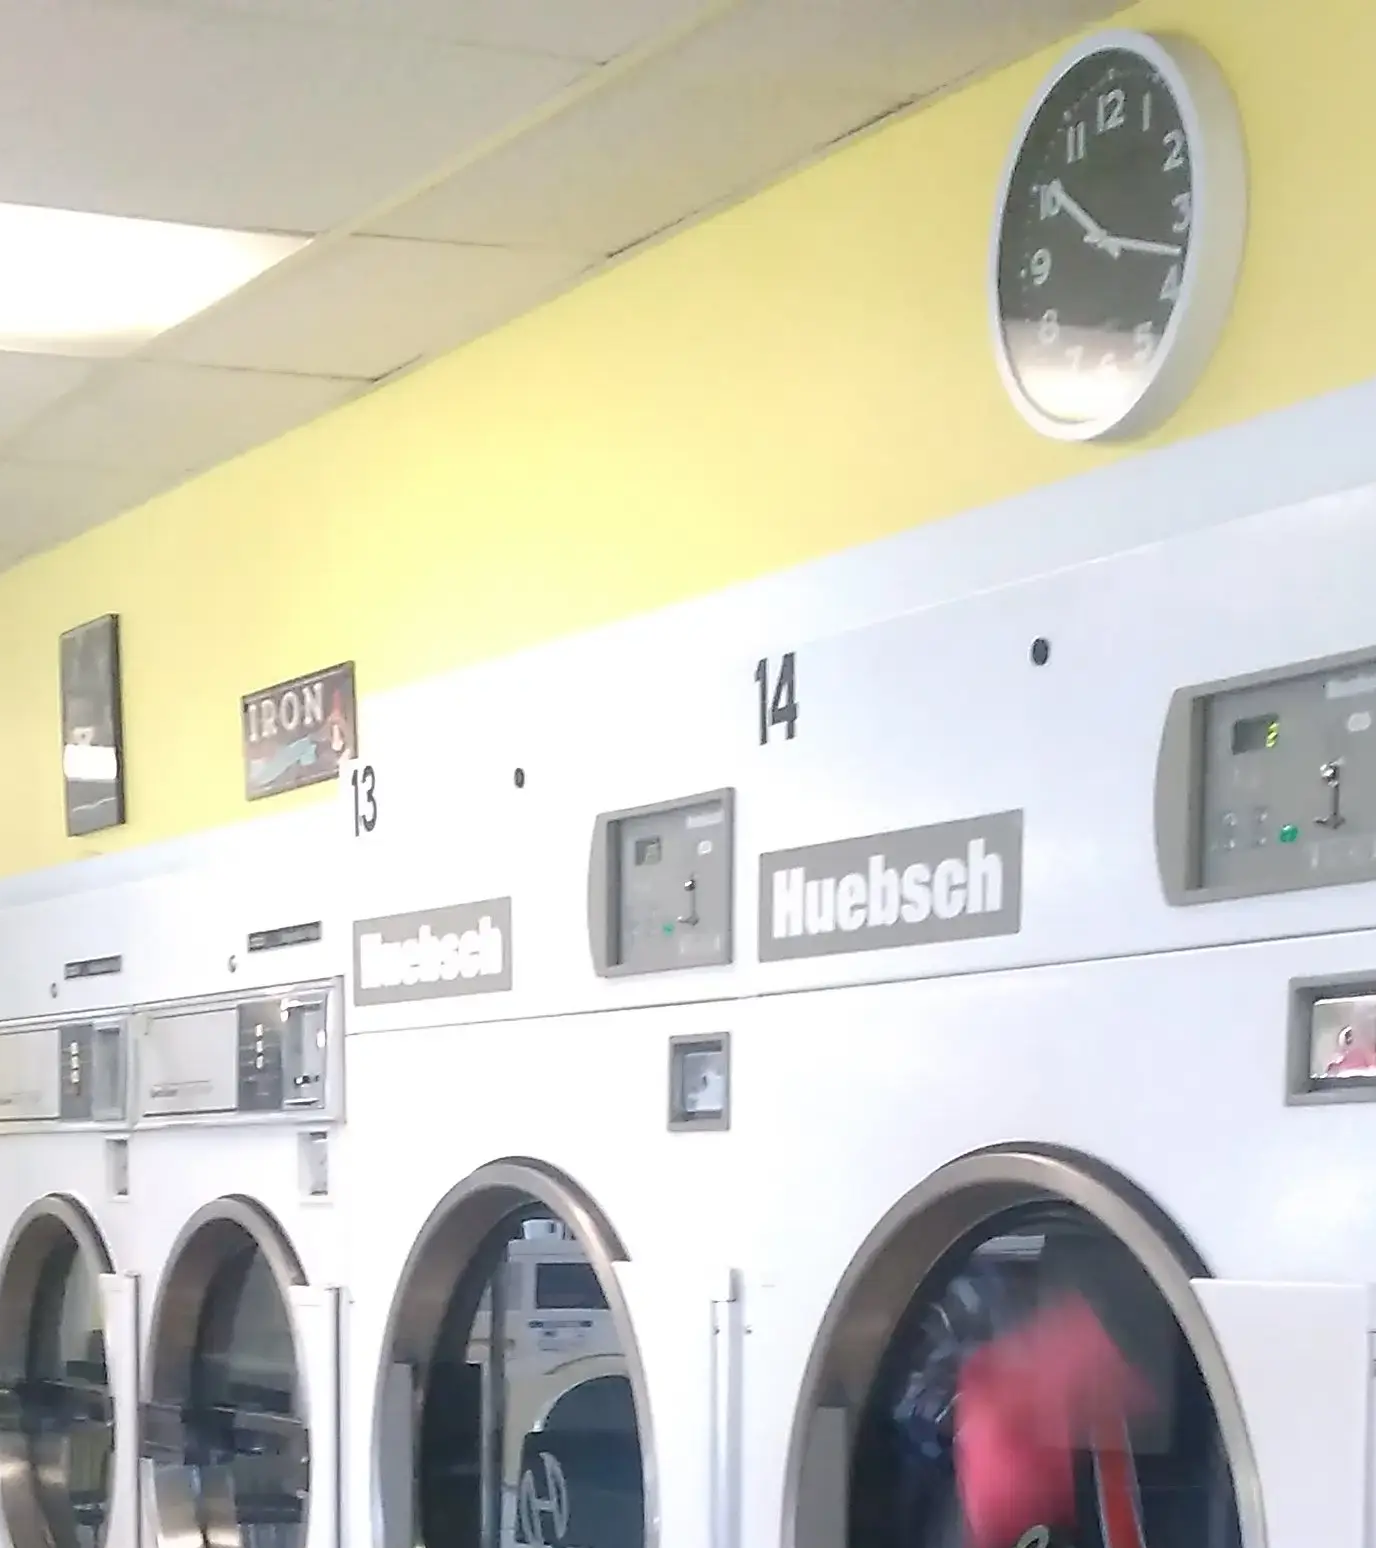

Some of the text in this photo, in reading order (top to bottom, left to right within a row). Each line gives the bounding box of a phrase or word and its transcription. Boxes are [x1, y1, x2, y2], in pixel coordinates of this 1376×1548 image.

[1097, 89, 1125, 134] 12
[1142, 90, 1151, 132] 1
[1067, 121, 1085, 164] 11
[1163, 129, 1186, 172] 2
[1171, 191, 1191, 232] 3
[1030, 248, 1052, 286] 9
[1159, 264, 1183, 301] 4
[1038, 308, 1060, 344] 8
[1133, 320, 1156, 361] 5
[248, 681, 324, 742] IRON
[754, 652, 798, 745] 14
[351, 765, 377, 837] 13
[773, 838, 1003, 939] Huebsch
